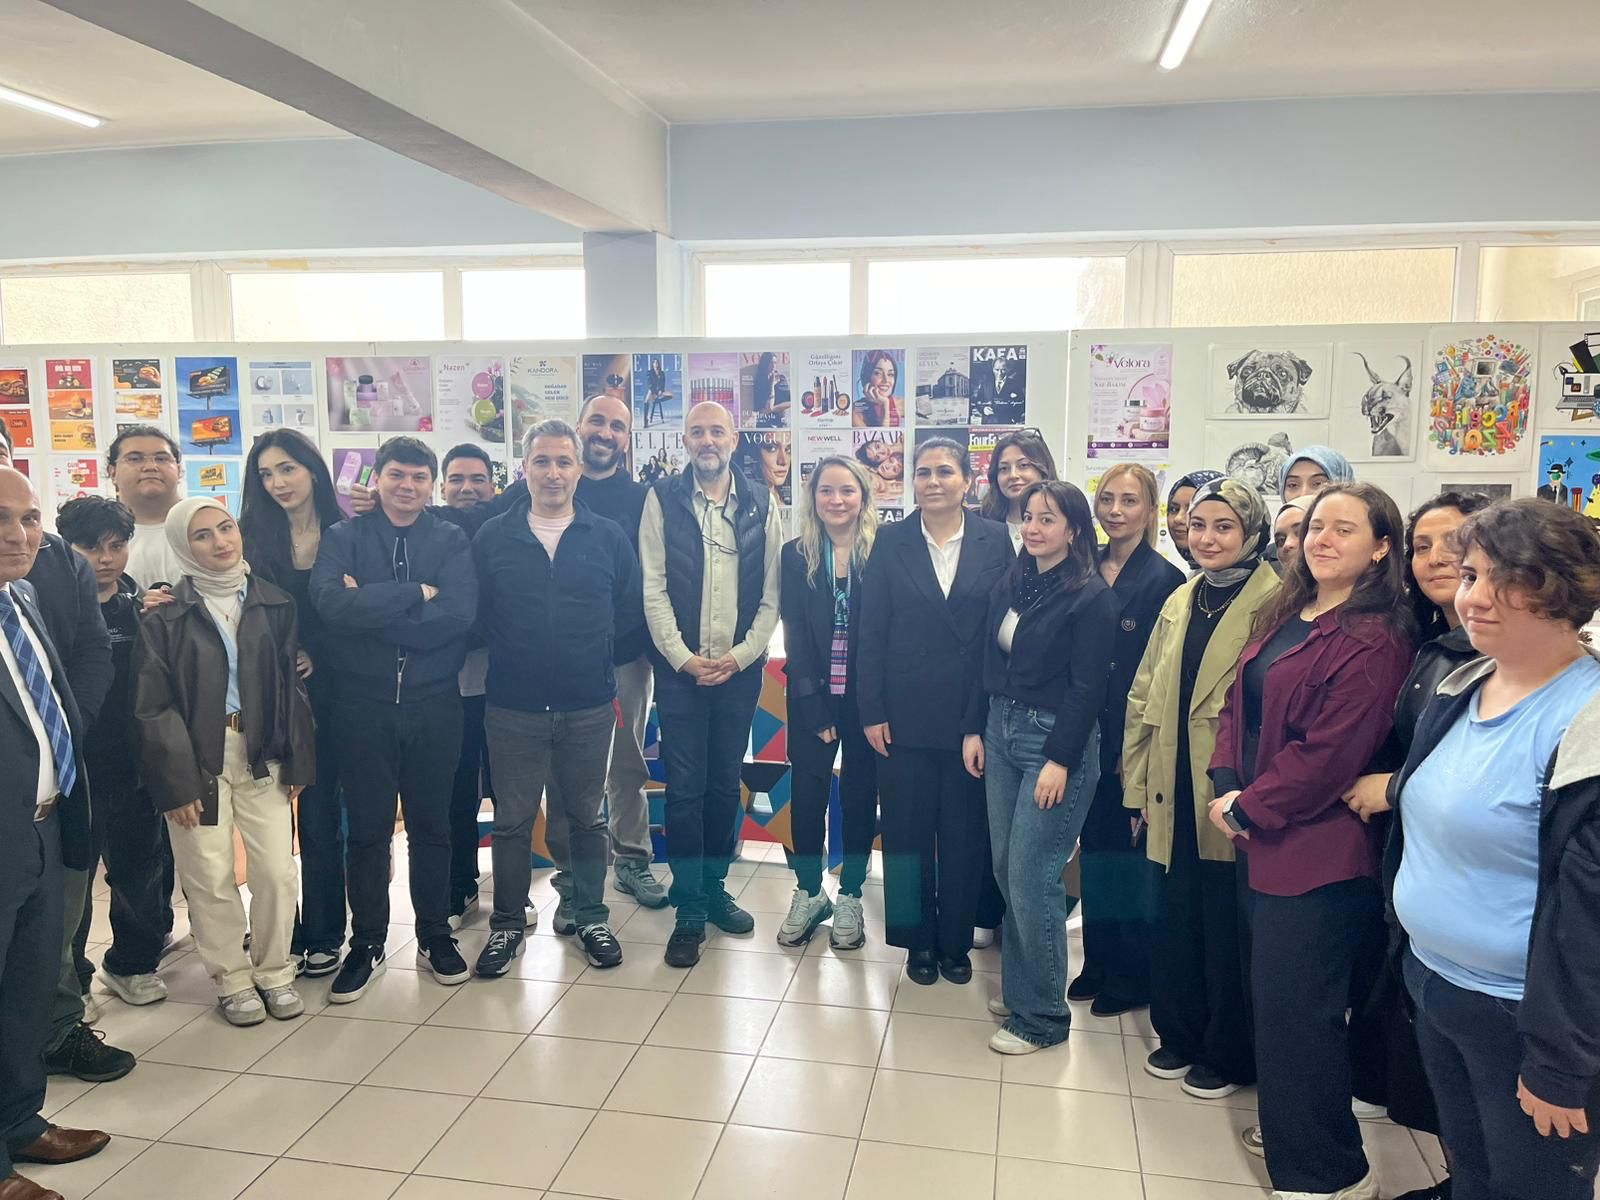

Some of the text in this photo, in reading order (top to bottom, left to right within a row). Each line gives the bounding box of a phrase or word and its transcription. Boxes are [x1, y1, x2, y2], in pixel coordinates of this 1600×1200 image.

[973, 347, 1018, 362] KAFA
[1114, 356, 1151, 369] Velora
[635, 432, 683, 449] ELLE
[744, 432, 791, 444] VOGUE
